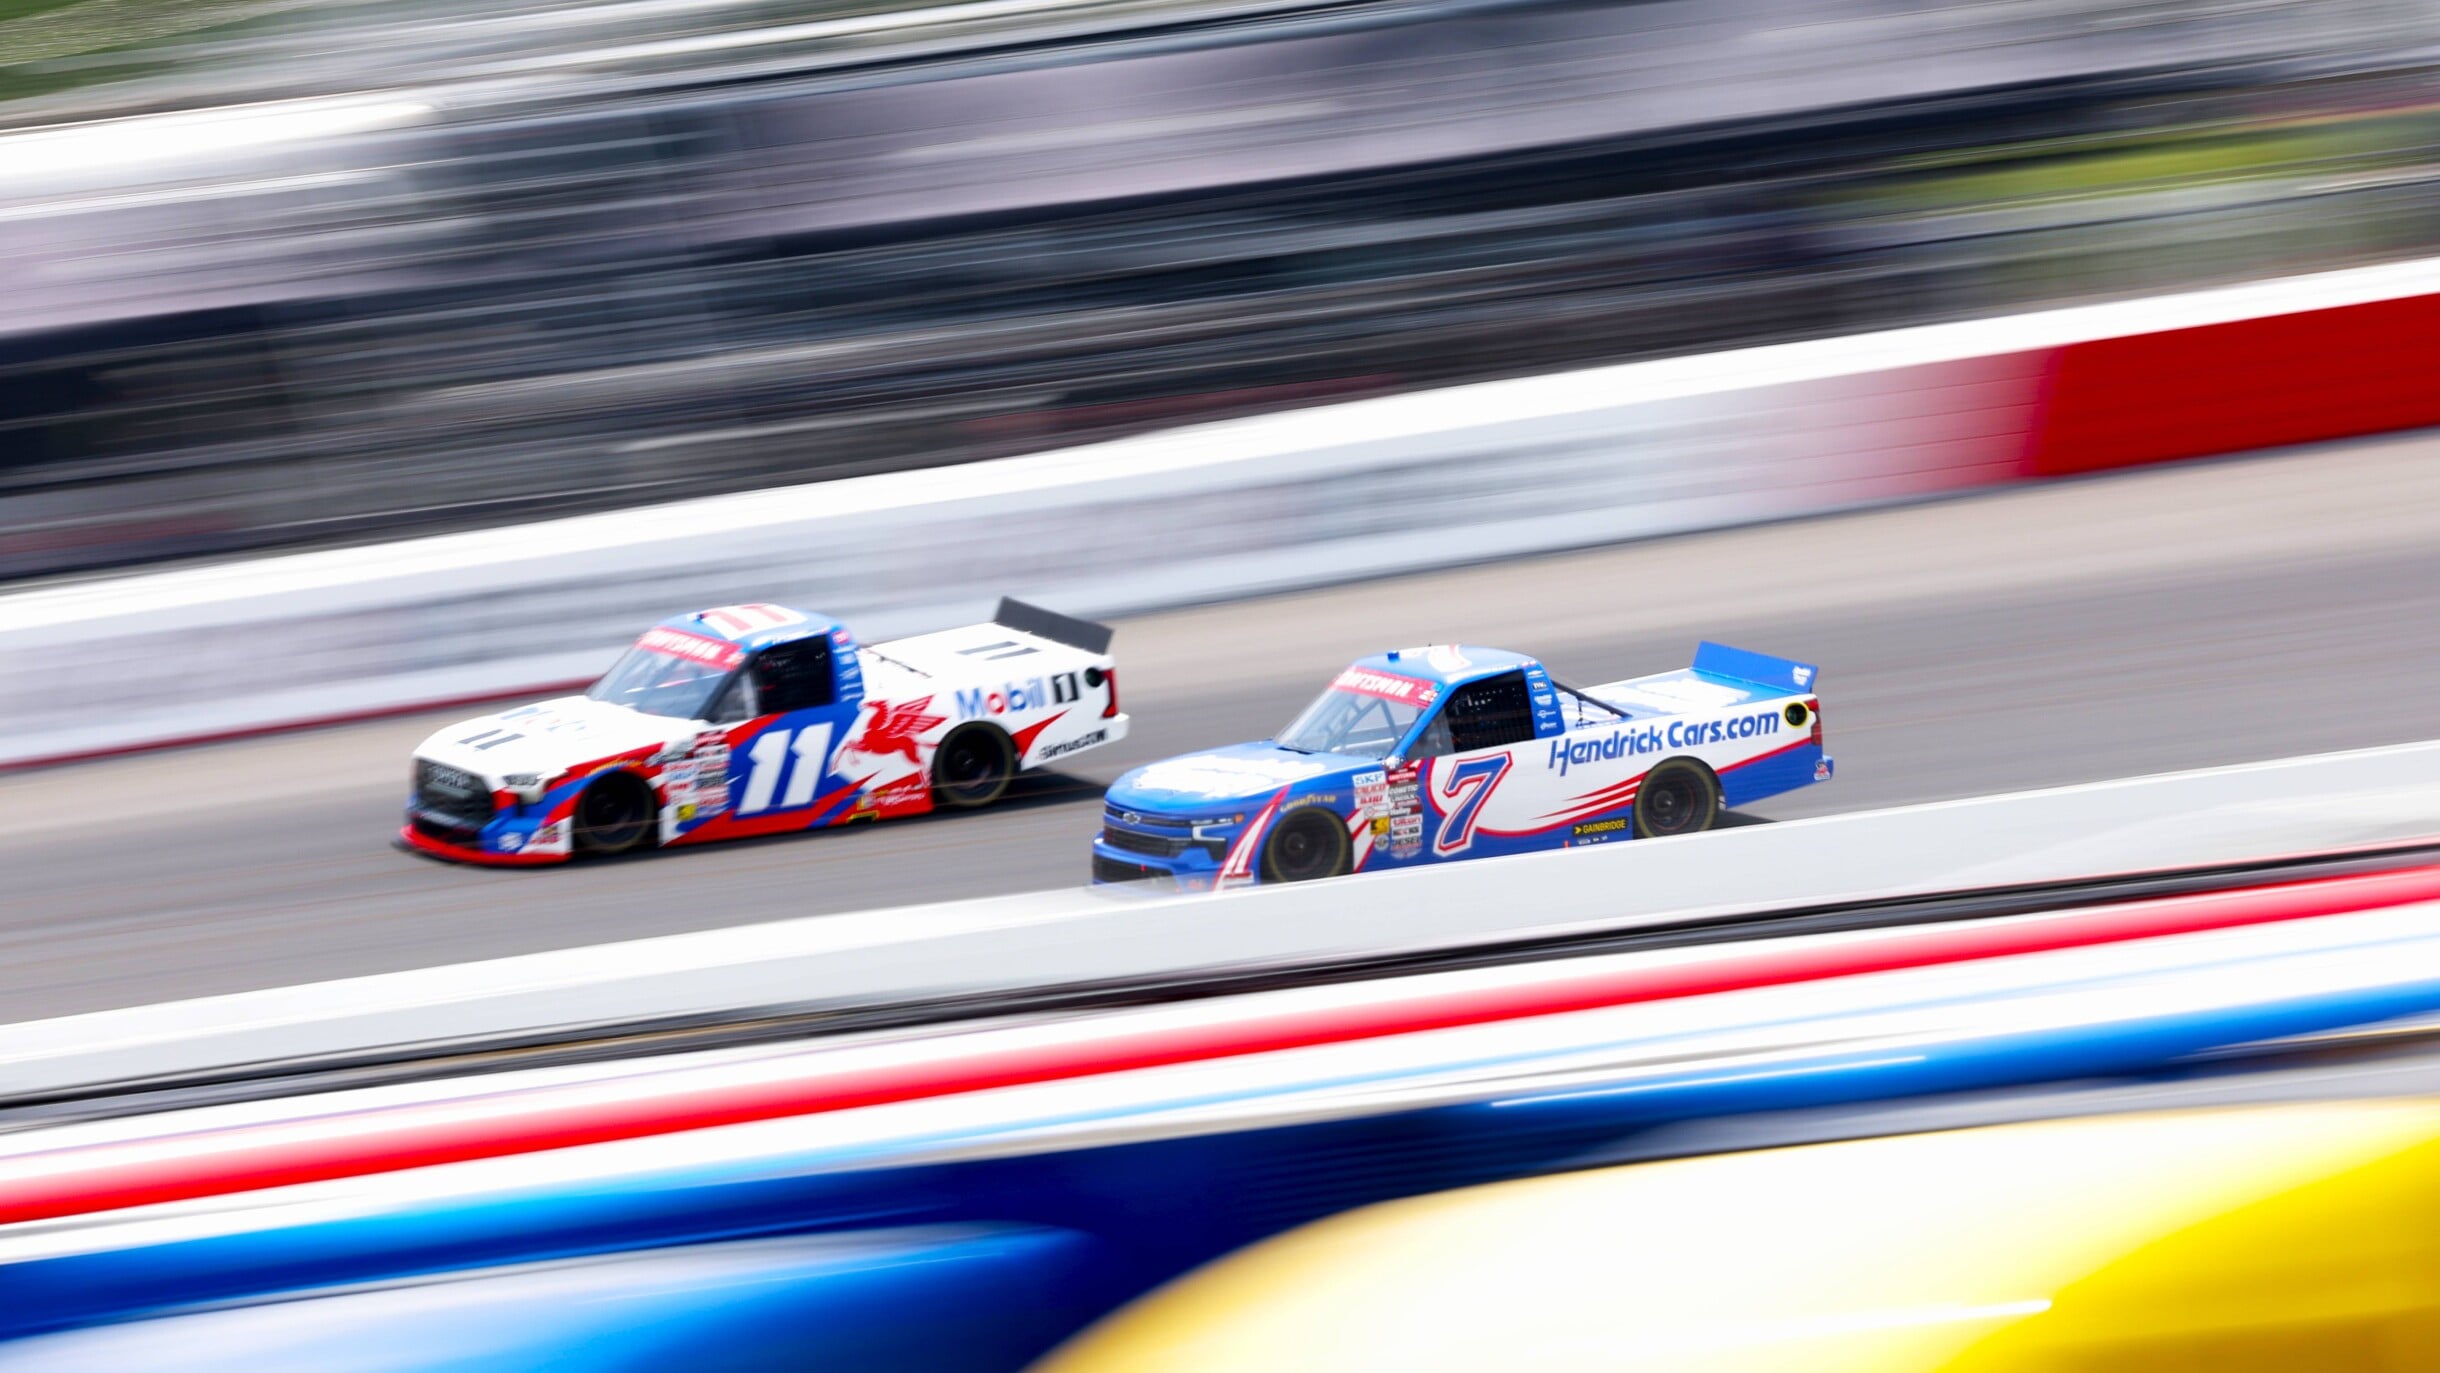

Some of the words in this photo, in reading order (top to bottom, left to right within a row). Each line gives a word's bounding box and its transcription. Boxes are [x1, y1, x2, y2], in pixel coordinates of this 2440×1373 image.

[704, 604, 808, 640] 11
[953, 640, 1042, 661] 11
[954, 675, 1046, 720] Mobil
[1053, 671, 1080, 704] 1
[456, 728, 526, 751] 11
[1548, 726, 1663, 777] Hendrick
[1667, 711, 1780, 748] Cars.com
[736, 720, 834, 815] 11
[1440, 750, 1513, 854] 7
[1582, 818, 1627, 834] GAINBRIDGE
